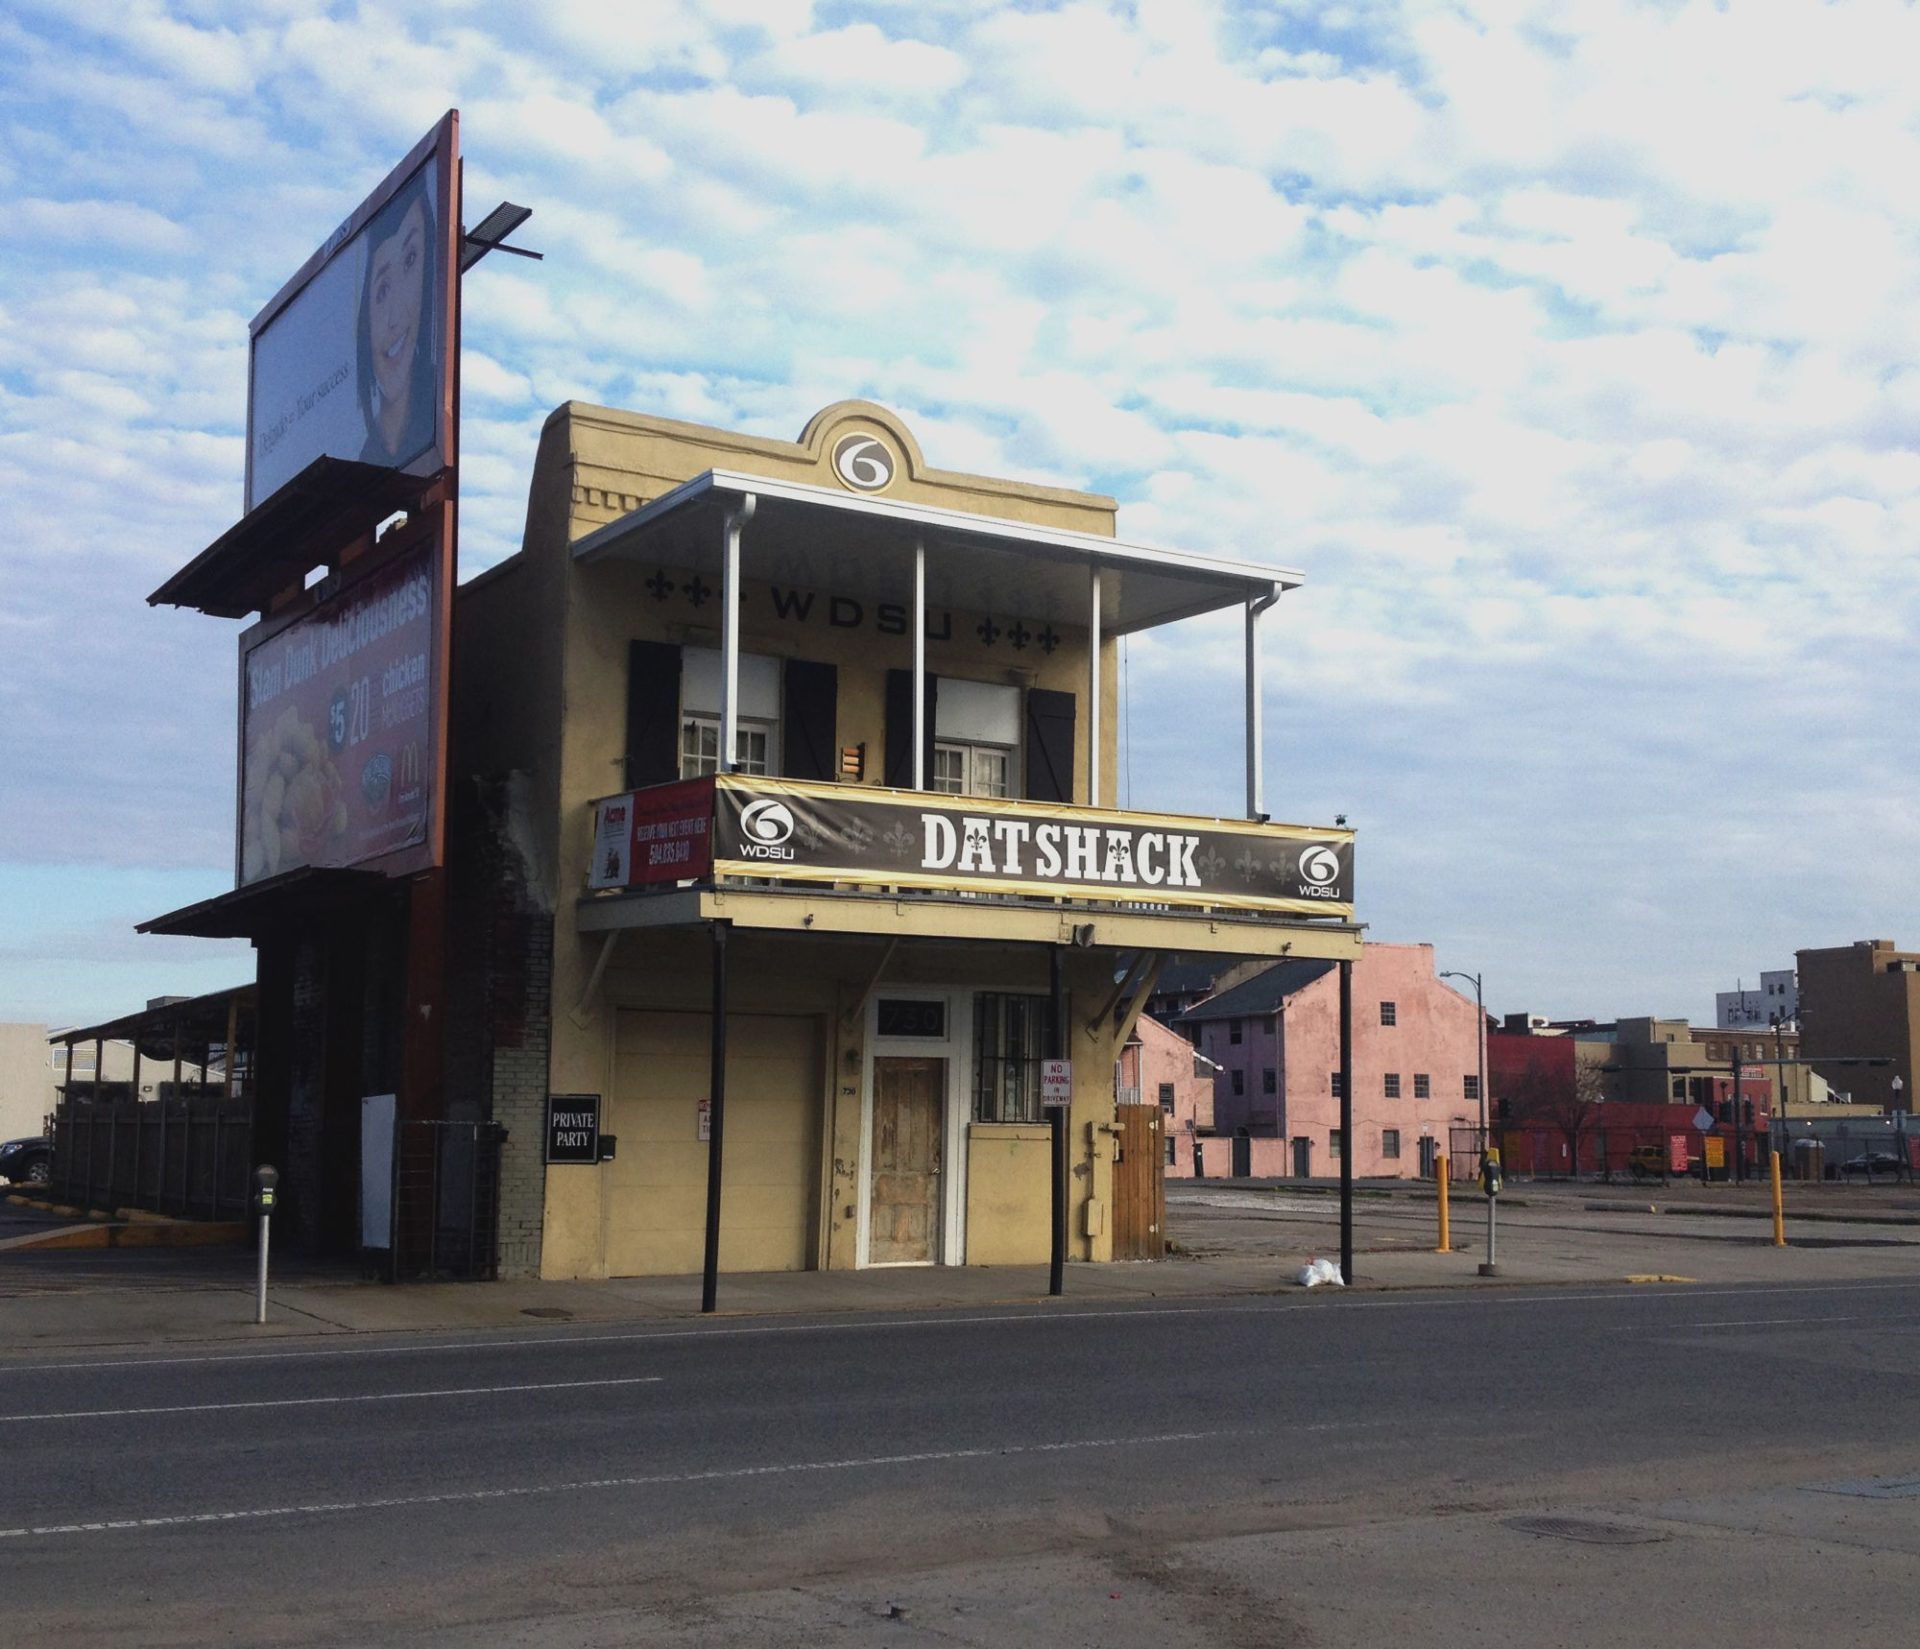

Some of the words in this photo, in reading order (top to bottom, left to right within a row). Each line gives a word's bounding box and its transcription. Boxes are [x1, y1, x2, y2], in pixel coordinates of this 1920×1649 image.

[839, 440, 889, 487] 6
[771, 586, 951, 640] WDSU
[251, 660, 282, 709] Slam
[285, 628, 318, 690] Dunk
[321, 575, 427, 670] Deliciousness
[382, 654, 426, 697] chicken
[351, 676, 369, 746] 20
[740, 843, 794, 860] WDSU
[1299, 884, 1340, 899] WDSU
[1050, 1064, 1063, 1074] NO
[1044, 1075, 1070, 1085] PARKING
[552, 1112, 595, 1128] PRIVATE
[556, 1131, 590, 1146] PARTY
